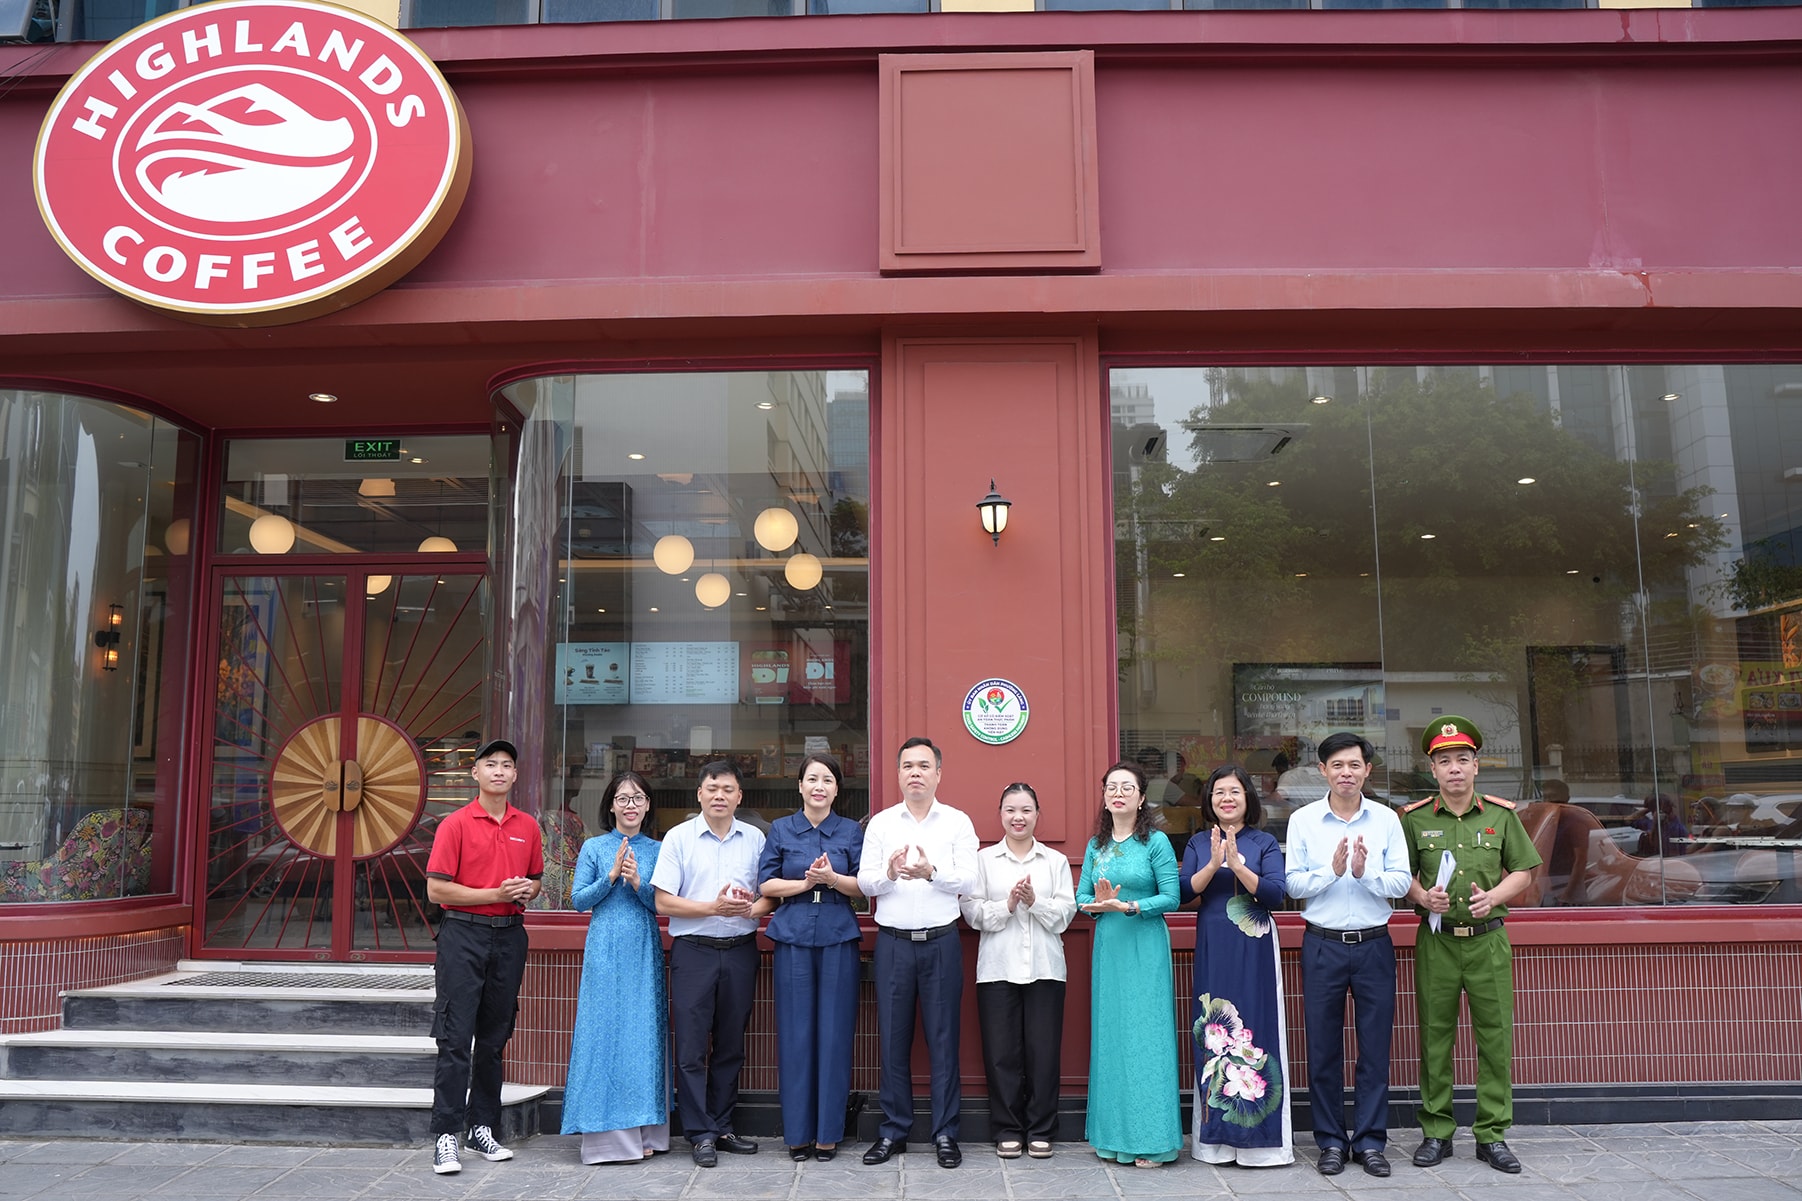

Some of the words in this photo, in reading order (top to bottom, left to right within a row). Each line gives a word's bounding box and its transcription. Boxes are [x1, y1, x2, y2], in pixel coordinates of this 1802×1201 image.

[71, 19, 426, 141] HIGHLANDS
[102, 215, 374, 290] COFFEE
[354, 442, 392, 452] EXIT
[1242, 692, 1302, 702] COMPOUND
